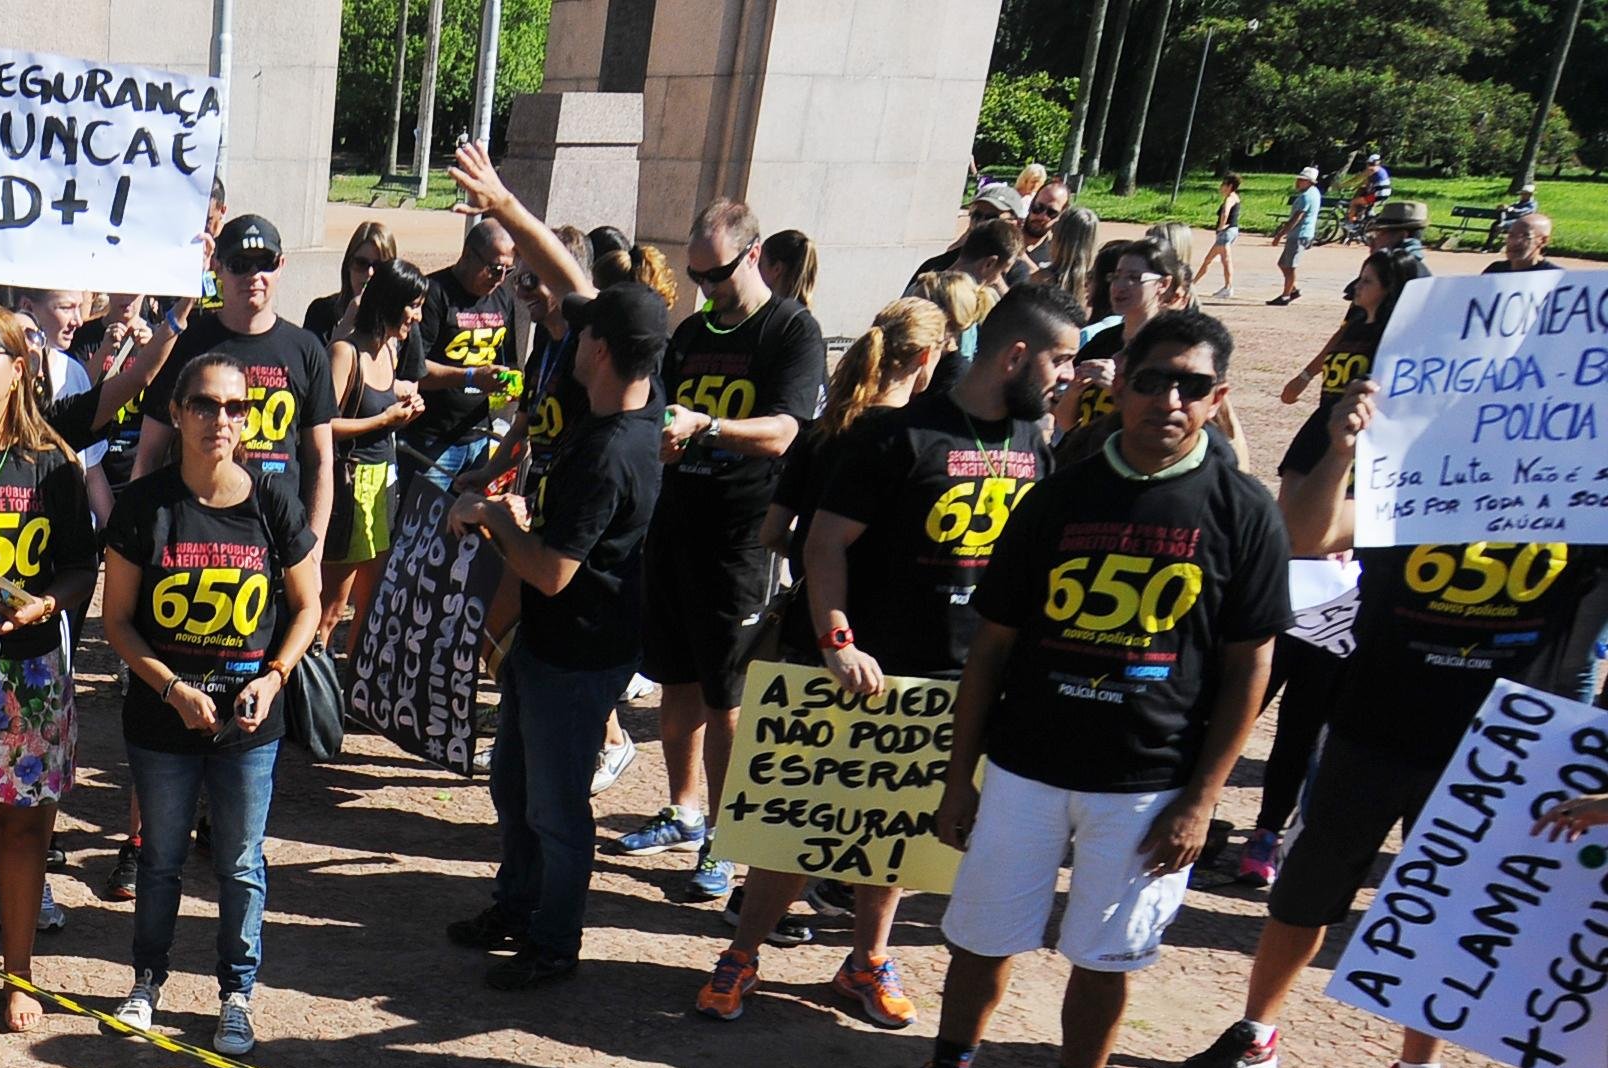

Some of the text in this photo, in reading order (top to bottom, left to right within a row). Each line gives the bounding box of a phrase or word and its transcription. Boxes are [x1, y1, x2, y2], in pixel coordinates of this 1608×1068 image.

[1389, 355, 1544, 398] BRIGADA
[1575, 348, 1608, 386] B
[240, 387, 295, 440] 50
[1472, 396, 1596, 443] POLÍCIA
[1370, 456, 1423, 490] Essa
[1439, 454, 1493, 486] Luta
[1513, 456, 1558, 485] Não
[925, 477, 1036, 546] 65
[1376, 499, 1414, 520] MAS
[1474, 494, 1524, 512] TODA
[1536, 493, 1550, 509] A
[1486, 516, 1567, 532] GAÚCHA
[162, 542, 218, 556] SURANÇA
[212, 554, 228, 567] DE
[450, 532, 480, 591] DO
[1404, 541, 1568, 605] 650
[153, 568, 269, 636] 650
[371, 499, 442, 730] GADOS PELO
[1043, 553, 1204, 634] 650
[175, 632, 244, 648] novos policiais
[394, 536, 445, 740] DECRETO
[447, 596, 484, 773] DECRETO
[761, 675, 954, 717] A SOCIED
[1057, 683, 1096, 699] POLÍCIA
[756, 708, 953, 754] NÃO PODE
[1362, 693, 1555, 960] POPULAÇÃO
[1423, 855, 1561, 1031] CLAMA
[1346, 970, 1401, 1008] A
